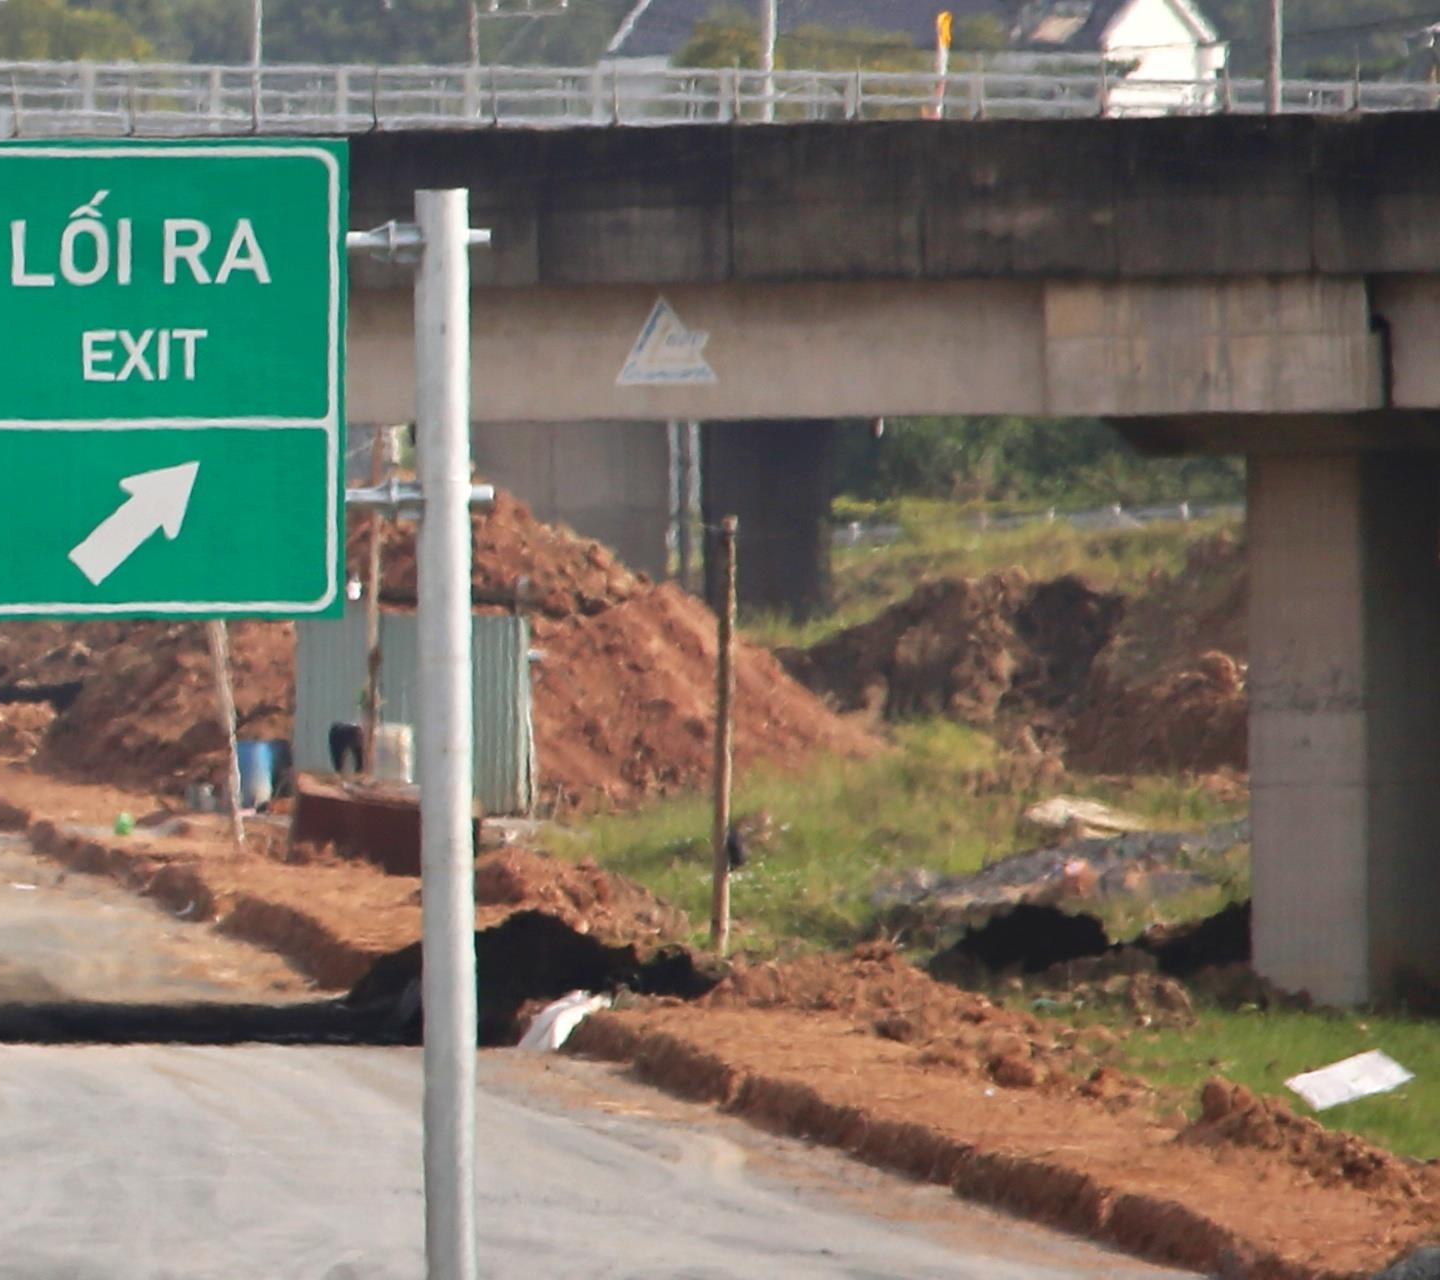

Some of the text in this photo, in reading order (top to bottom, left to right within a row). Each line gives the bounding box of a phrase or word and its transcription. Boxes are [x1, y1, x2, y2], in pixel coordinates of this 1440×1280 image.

[10, 190, 272, 288] LỐI RA
[81, 329, 209, 382] EXIT
